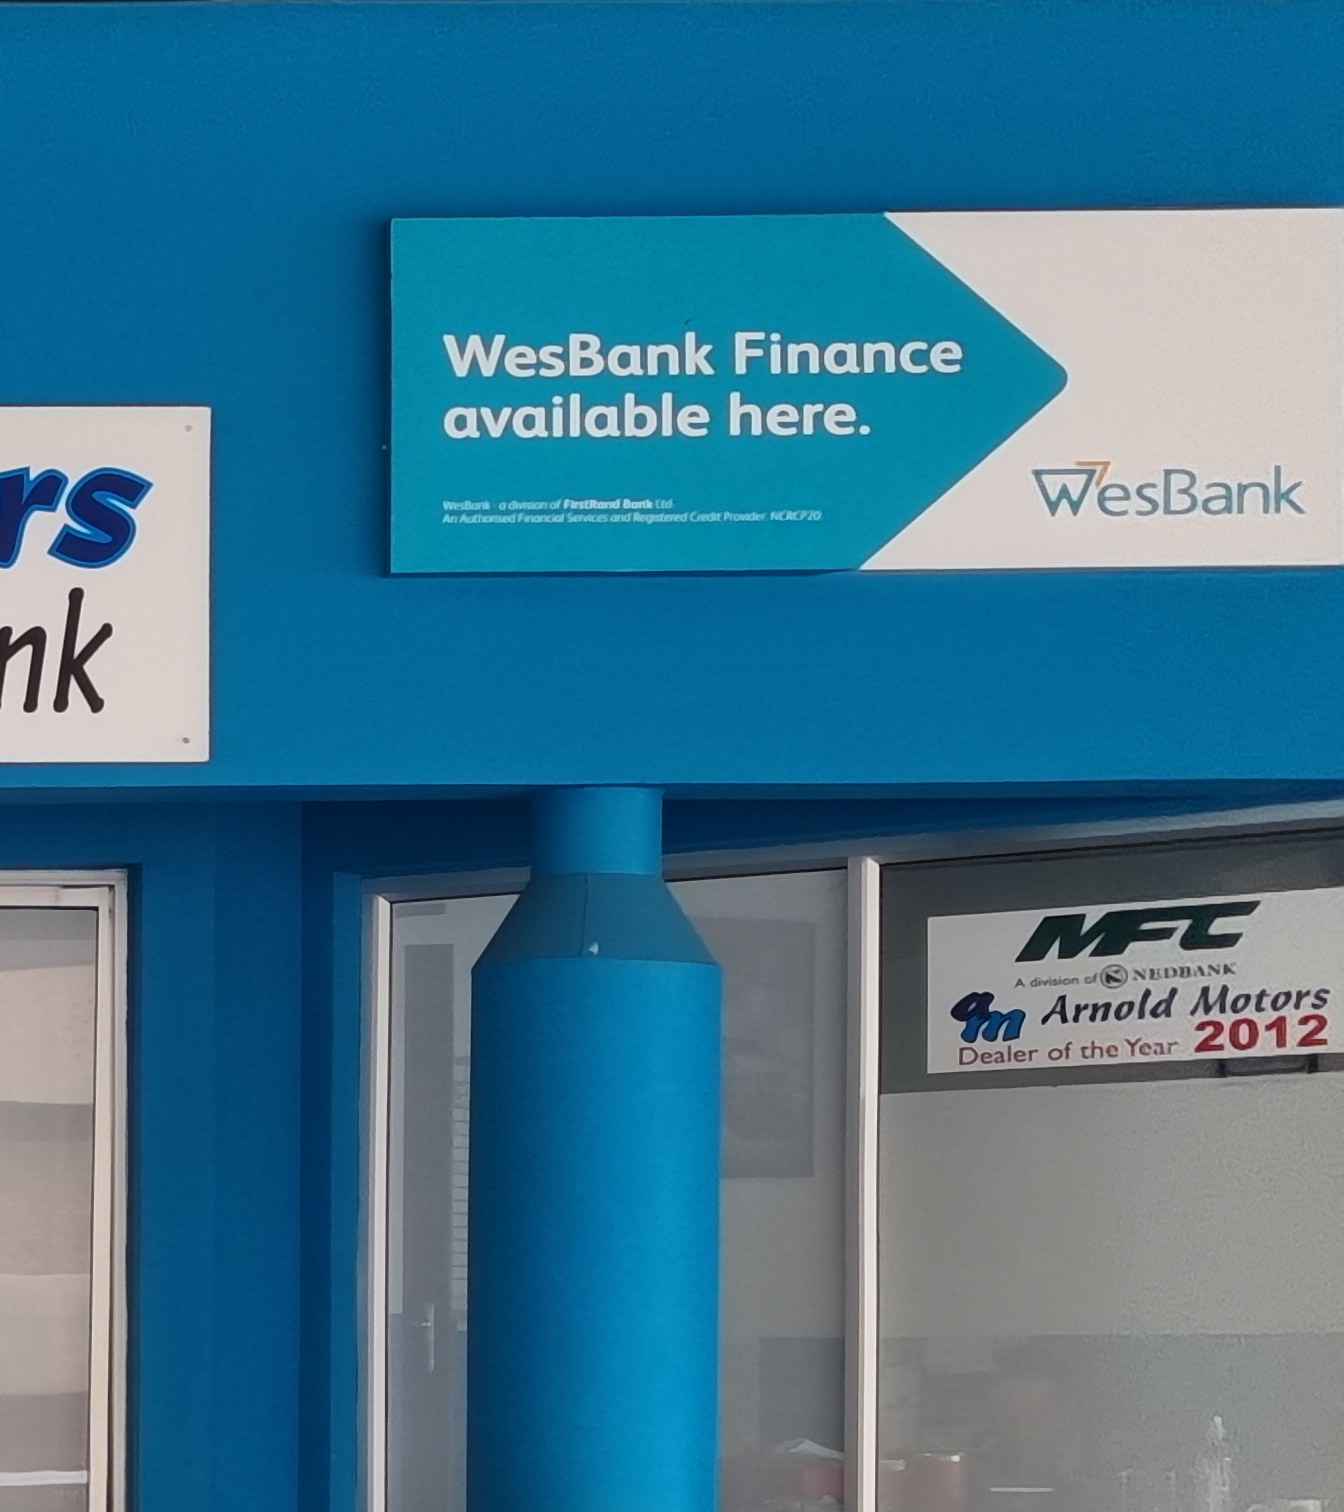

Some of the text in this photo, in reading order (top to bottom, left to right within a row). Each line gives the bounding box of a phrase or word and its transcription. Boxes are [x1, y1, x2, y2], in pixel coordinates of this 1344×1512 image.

[442, 330, 963, 378] WesBank Finance
[443, 392, 870, 439] available here.
[442, 500, 490, 511] WesBank
[498, 501, 507, 510] a
[508, 500, 547, 511] division
[550, 498, 562, 510] of
[563, 498, 620, 510] FirstRand
[623, 498, 653, 509] Bank
[1031, 460, 1305, 518] WesBank
[442, 513, 458, 524] An
[459, 513, 516, 524] Authorised
[517, 512, 564, 523] Financial
[566, 512, 608, 523] Services
[610, 512, 632, 523] and
[633, 512, 689, 525] Registered
[690, 511, 723, 522] Credit
[1014, 900, 1261, 962] MFC
[1014, 962, 1238, 989] A division of NEDBANK
[1041, 984, 1331, 1025] Arnold Motors
[958, 1013, 1329, 1066] Dealer of the Year 2012
